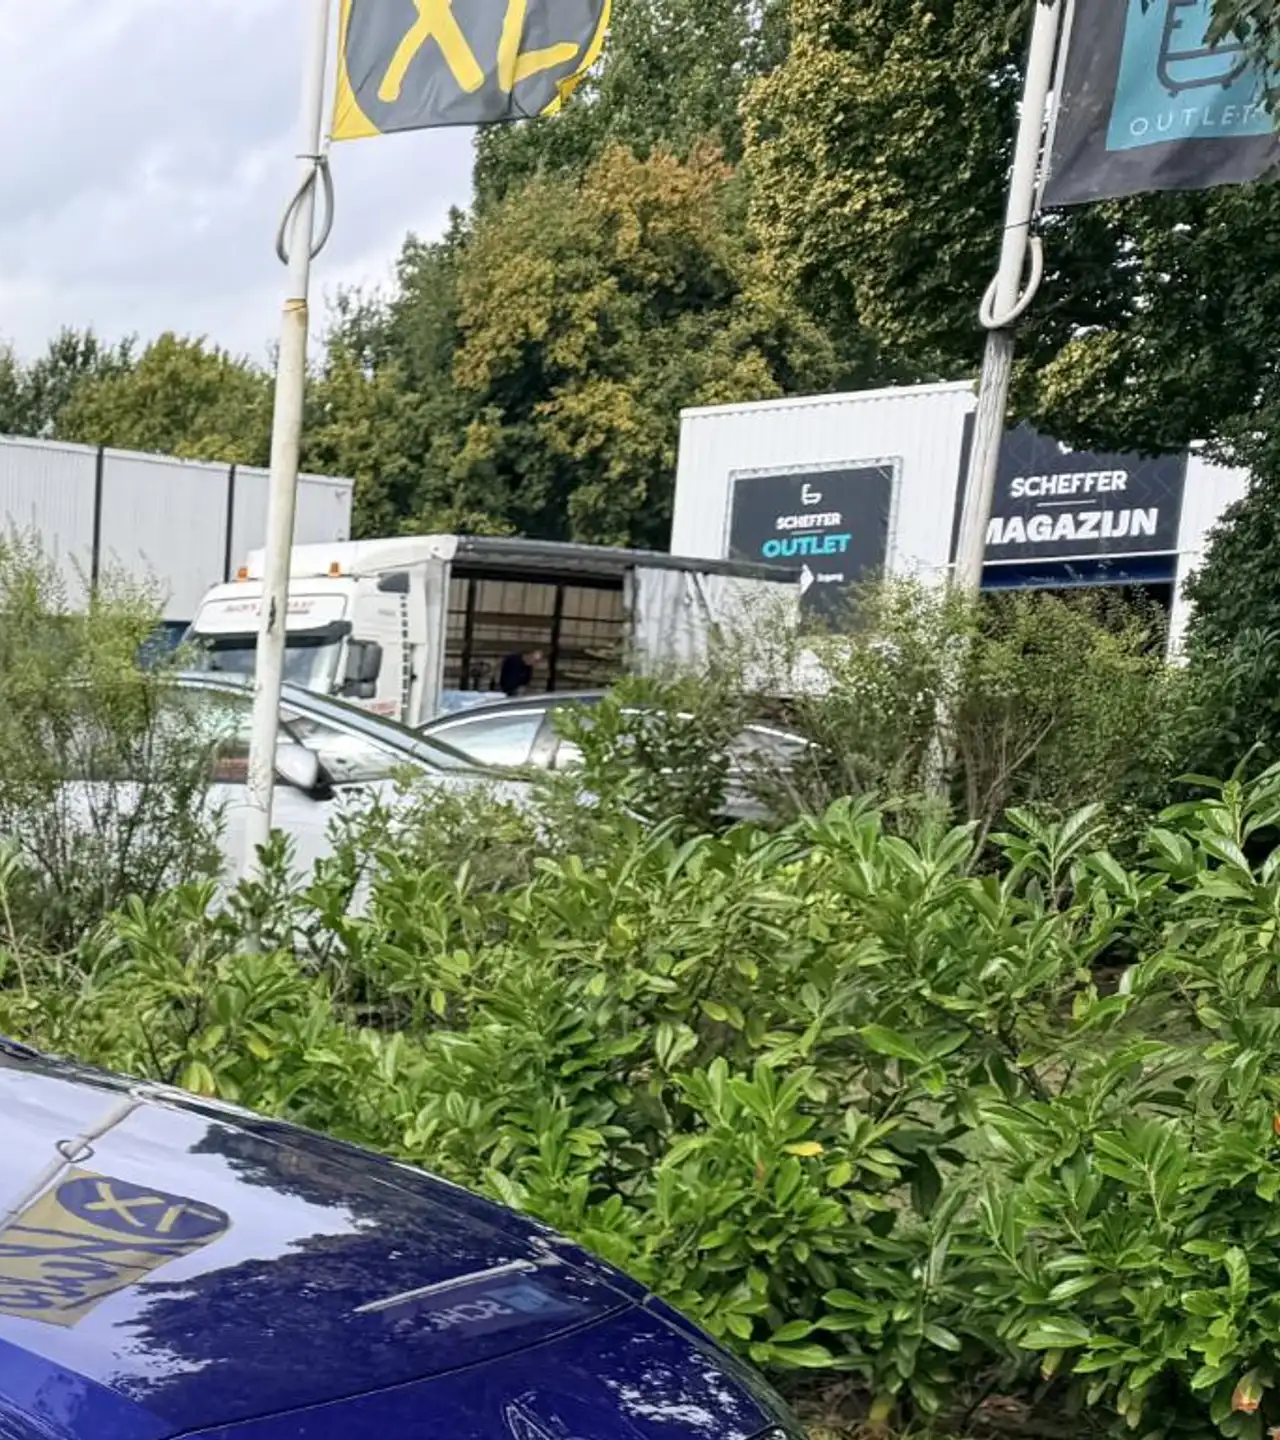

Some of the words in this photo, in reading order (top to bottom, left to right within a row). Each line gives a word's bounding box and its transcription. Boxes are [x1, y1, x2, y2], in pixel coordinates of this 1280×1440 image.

[378, 0, 579, 103] XL
[1129, 104, 1256, 136] OUTLET
[1009, 469, 1128, 498] SCHEFFER
[776, 512, 842, 530] SCHEFFER
[761, 533, 853, 558] OUTLET
